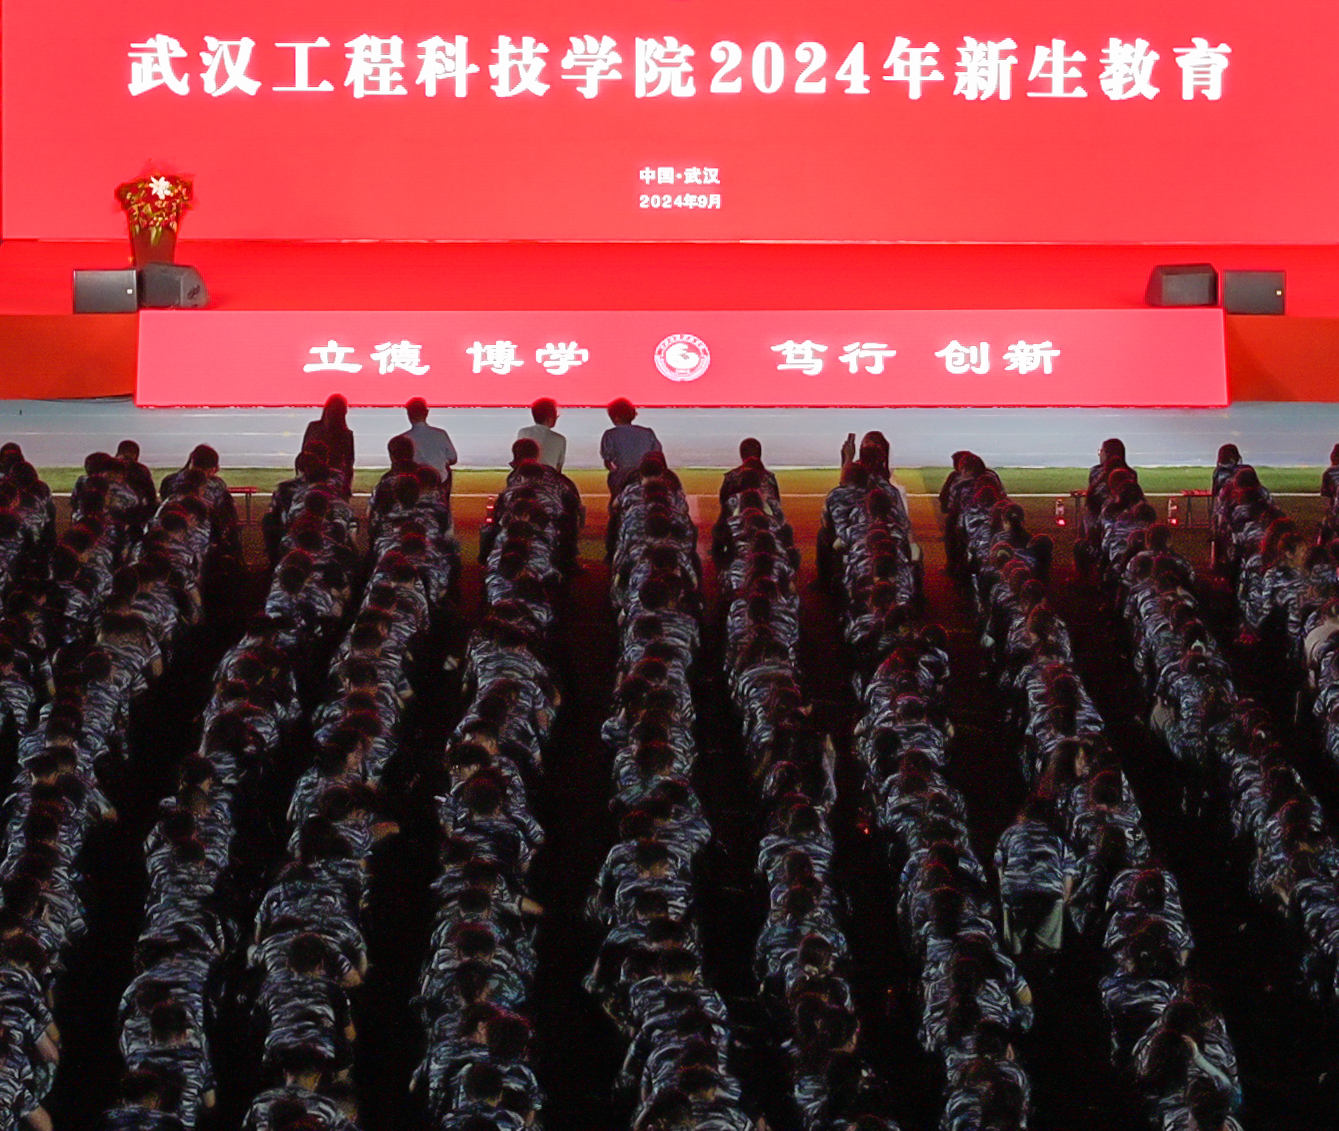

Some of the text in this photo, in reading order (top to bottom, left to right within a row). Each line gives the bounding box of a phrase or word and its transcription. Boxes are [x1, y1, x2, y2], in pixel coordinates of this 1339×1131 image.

[126, 33, 1233, 101] 武汉工程科技学院2024年新生教育
[639, 166, 721, 185] 中国·武汉
[639, 193, 721, 210] 2024年9月
[302, 339, 1061, 376] 立德 博学 笃行 创新
